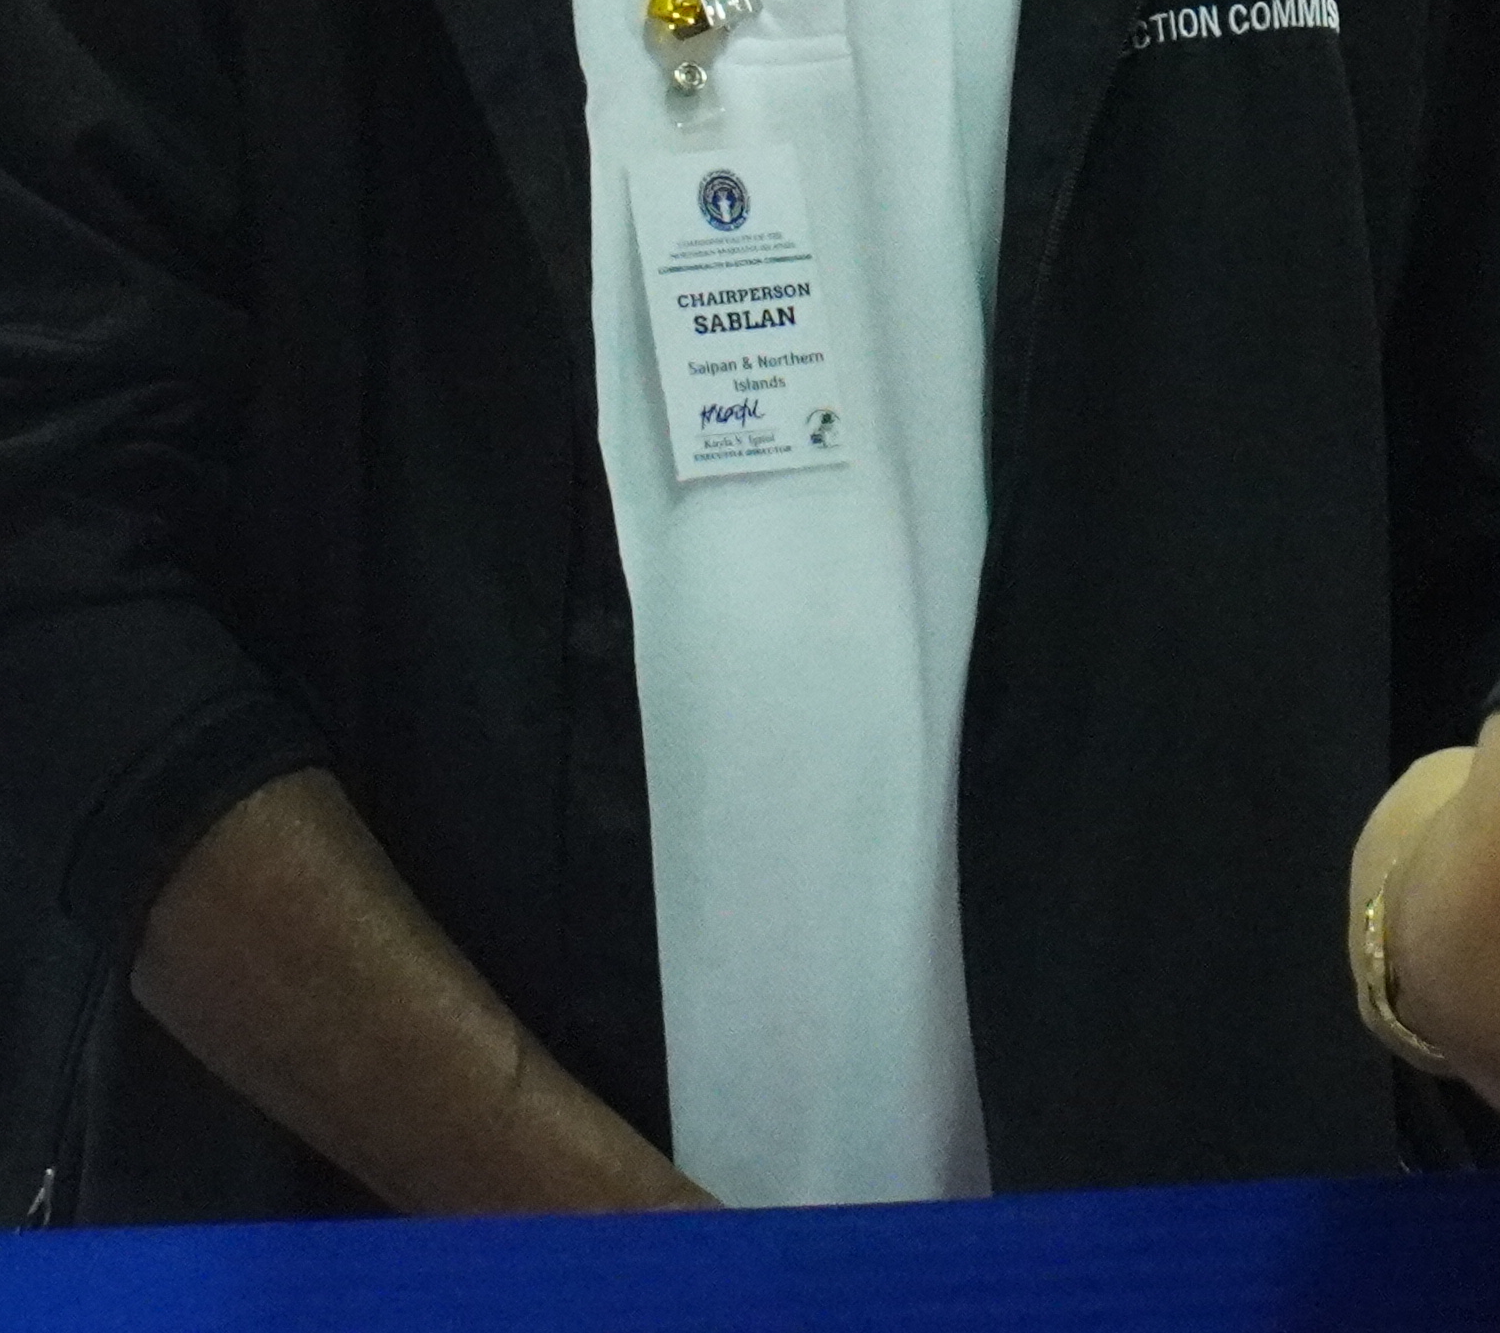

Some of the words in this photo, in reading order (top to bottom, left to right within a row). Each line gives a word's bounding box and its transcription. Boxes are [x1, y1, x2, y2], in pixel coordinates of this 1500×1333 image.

[678, 282, 811, 308] CHAIRPERSON
[694, 306, 797, 335] SABLAN
[688, 360, 737, 376] Saipan
[742, 356, 753, 370] &
[757, 351, 825, 369] Northern
[733, 375, 786, 392] Islands
